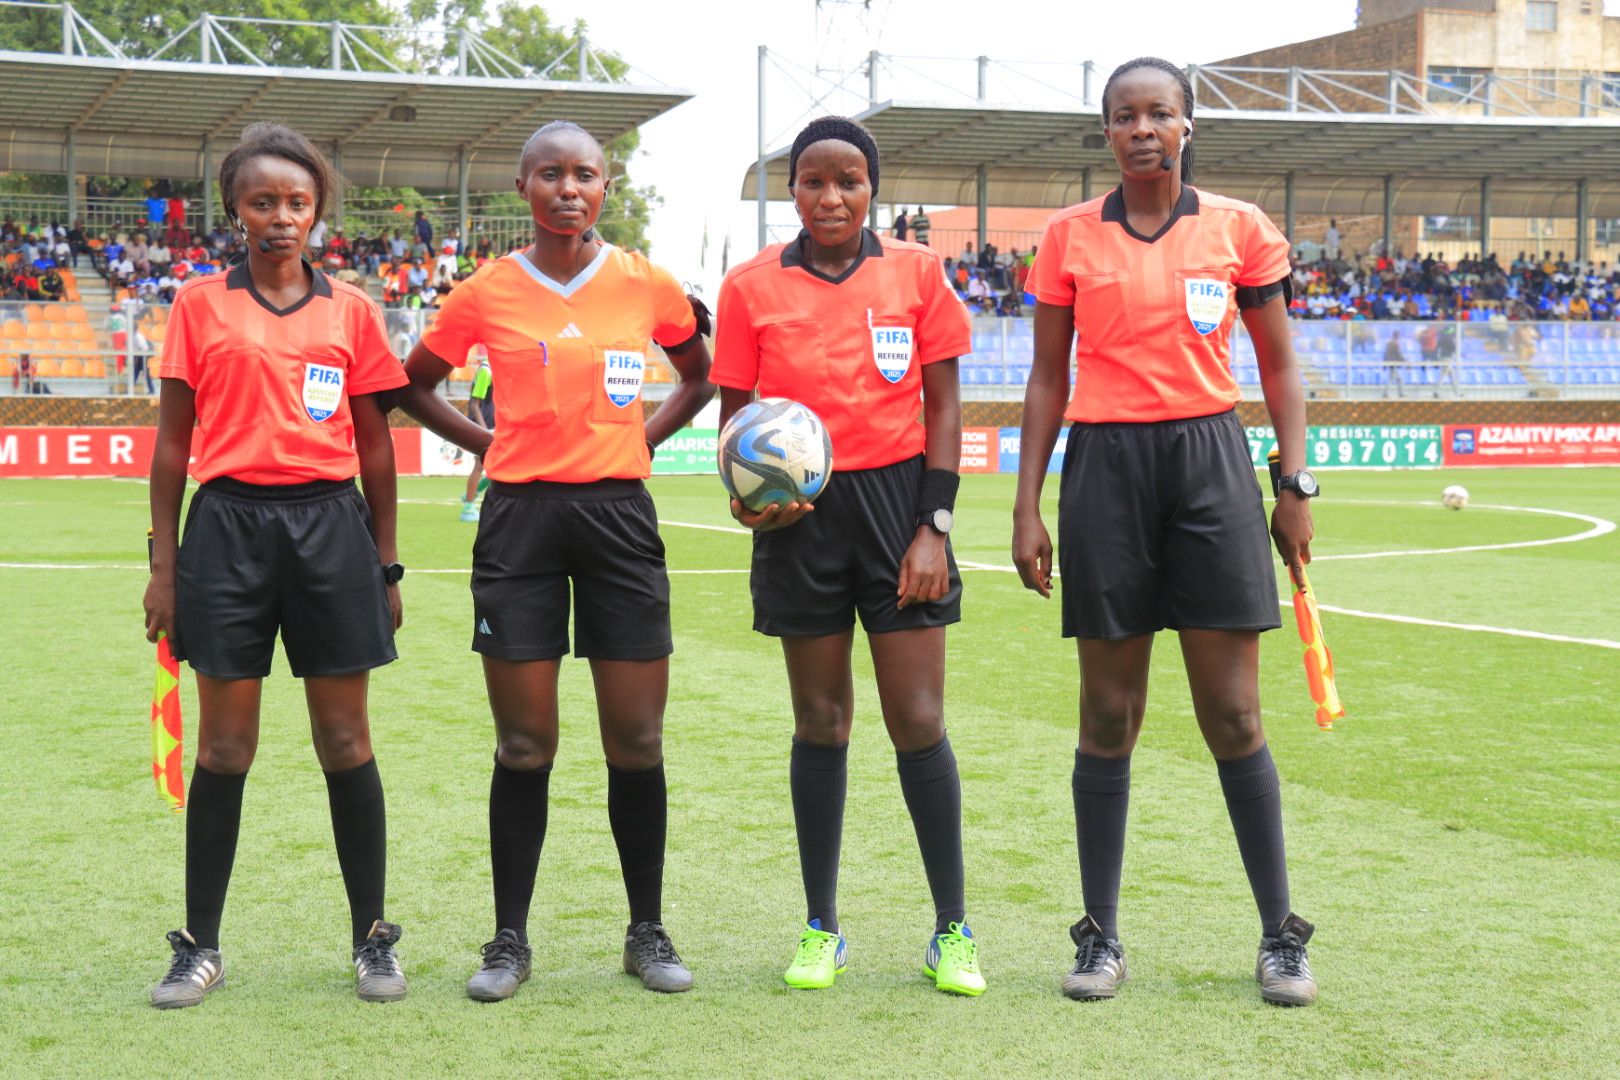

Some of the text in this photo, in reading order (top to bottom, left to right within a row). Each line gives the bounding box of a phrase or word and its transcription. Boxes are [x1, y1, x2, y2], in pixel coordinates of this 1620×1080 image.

[1190, 283, 1224, 298] FIFA
[876, 331, 909, 344] FIFA
[609, 355, 642, 370] FIFA
[877, 352, 908, 360] REFEREE
[309, 367, 340, 386] FIFA
[607, 377, 640, 385] REFEREE
[1593, 426, 1620, 443] AP
